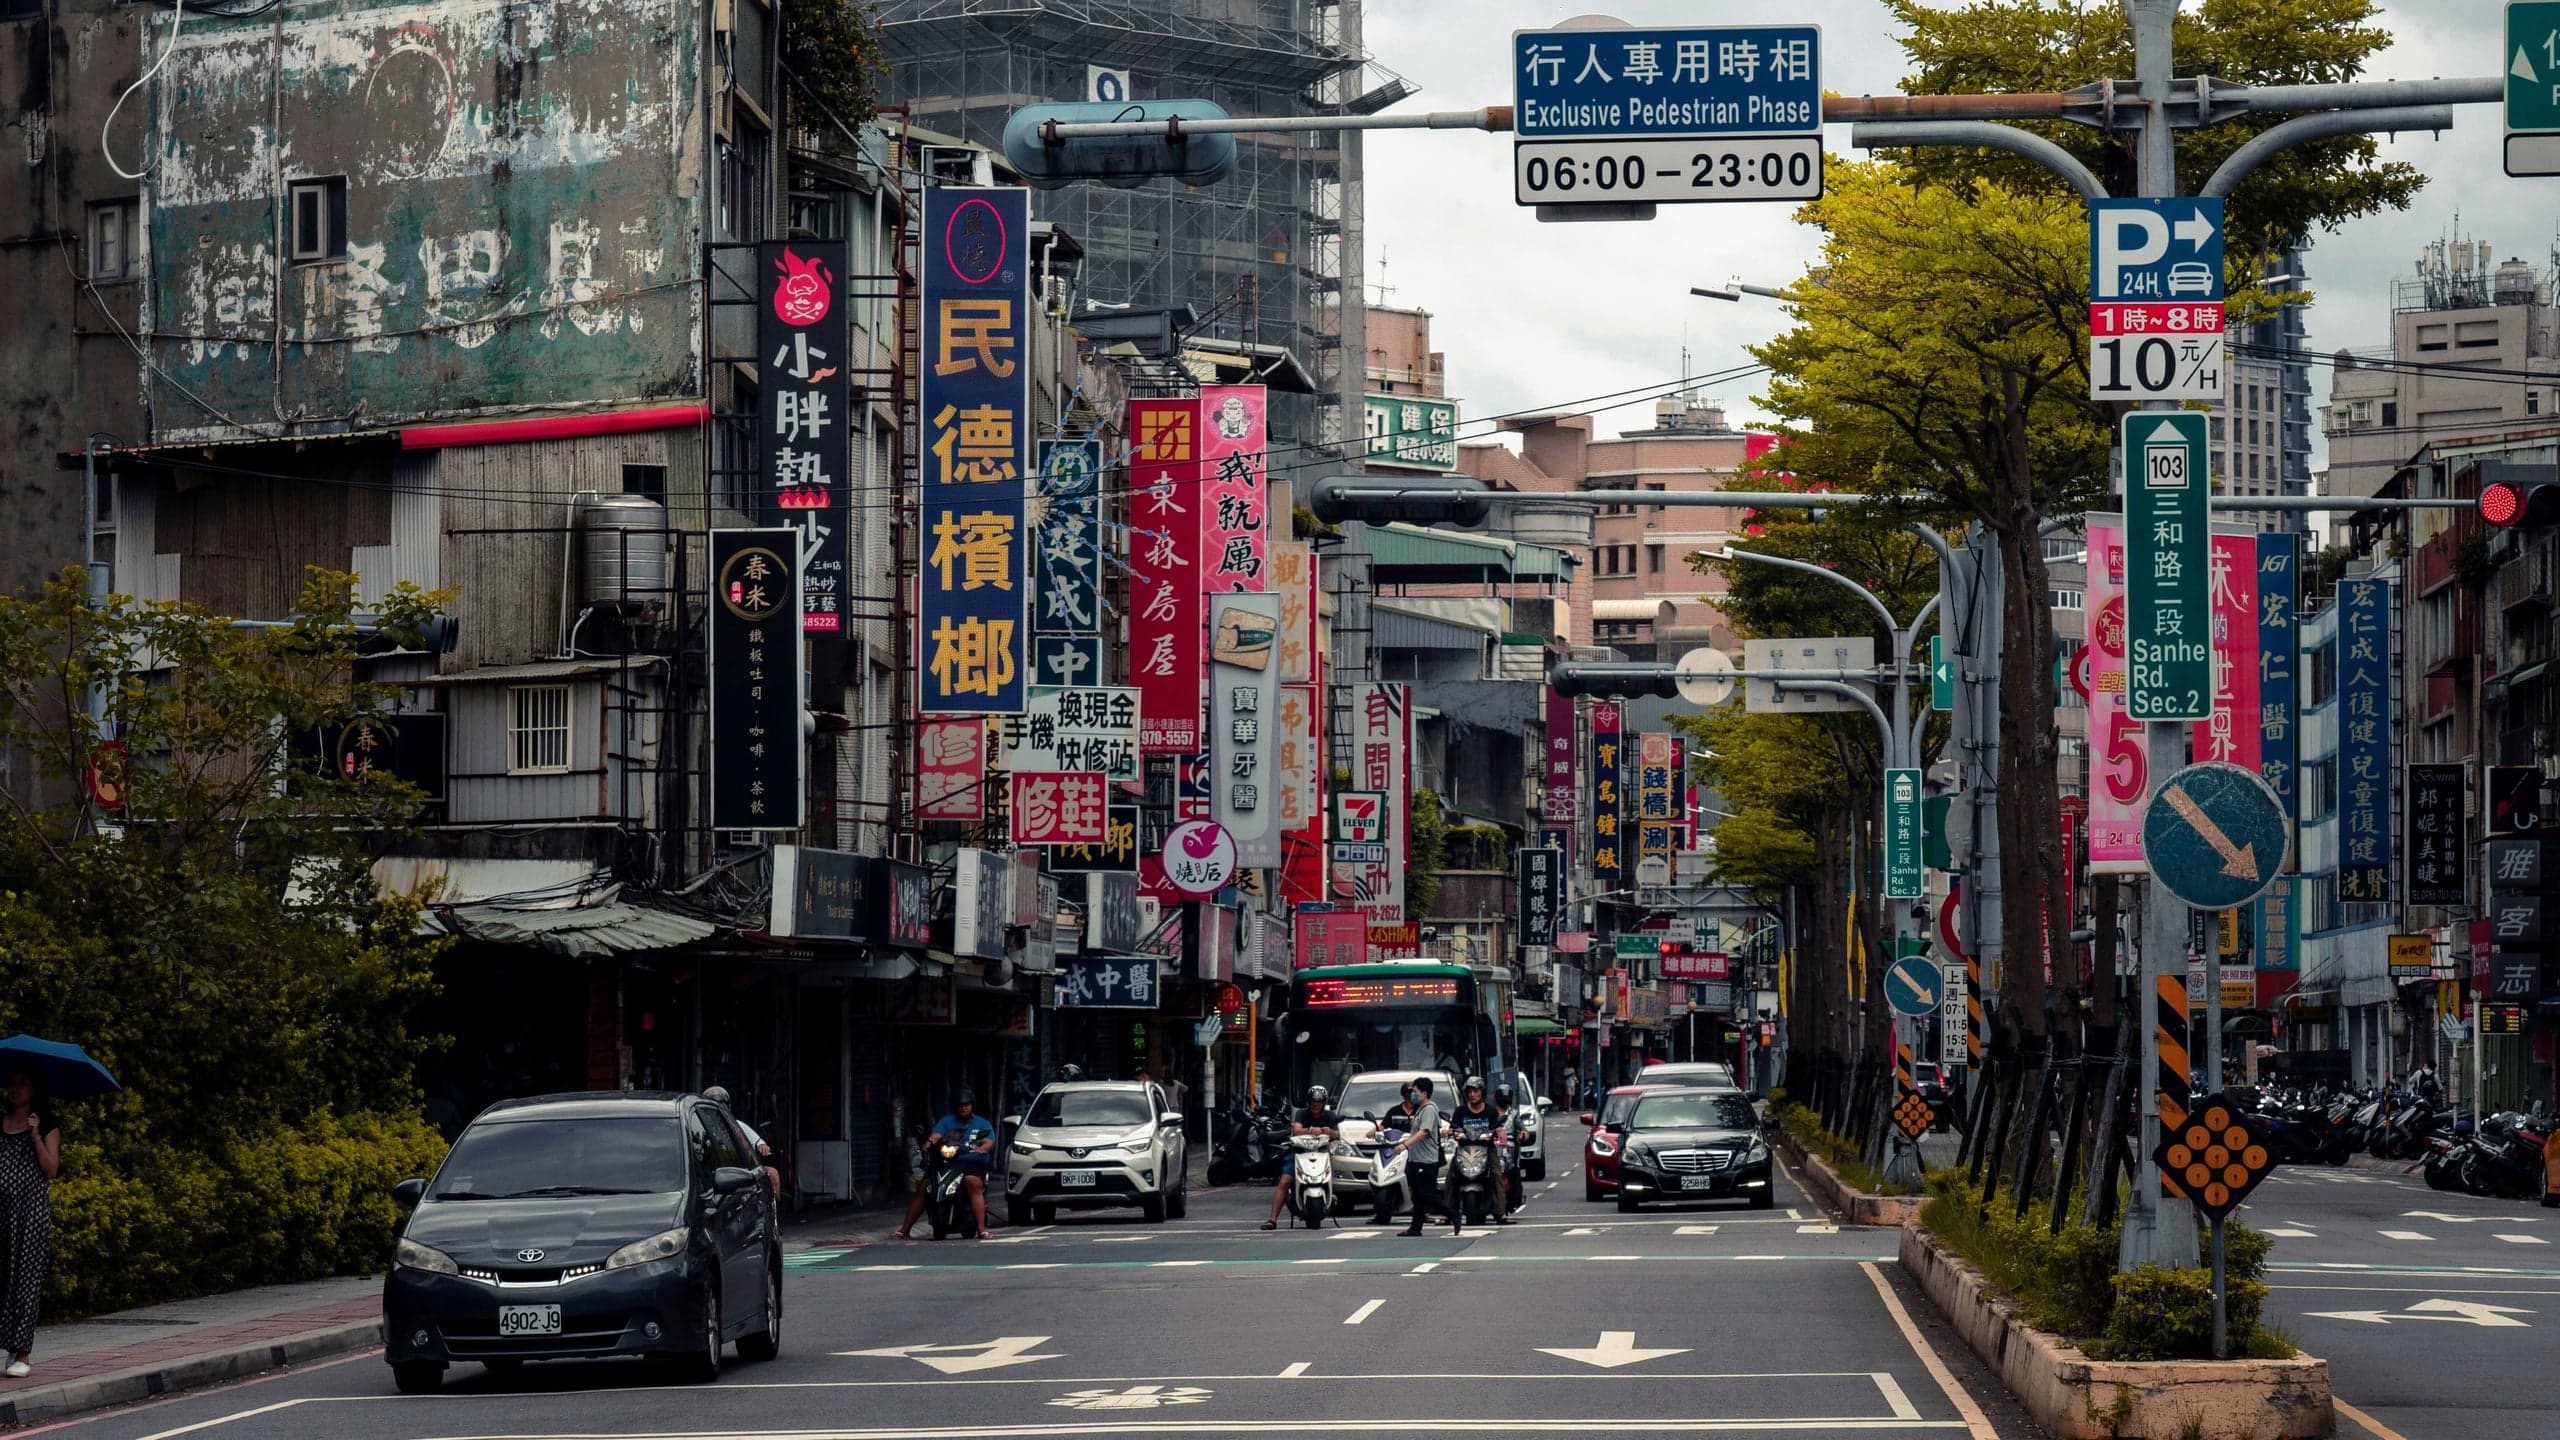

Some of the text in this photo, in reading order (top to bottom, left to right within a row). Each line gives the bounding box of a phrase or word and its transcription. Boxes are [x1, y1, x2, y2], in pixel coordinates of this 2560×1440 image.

[1525, 39, 1811, 87] 行人專用時相
[1524, 95, 1811, 127] Exclusive Pedestrian Phase
[2098, 208, 2170, 297] P
[2123, 272, 2159, 295] 24H
[2150, 455, 2183, 479] 103
[929, 299, 1017, 697] 民德檳榔
[744, 554, 771, 611] 春米
[814, 560, 842, 571] 三和店
[1141, 470, 1189, 677] 東森房屋
[2152, 493, 2184, 637] 三和路二段
[2133, 638, 2205, 663] Sanhe
[2134, 664, 2169, 689] Rd.
[2259, 592, 2291, 795] 宏仁醫院
[1004, 713, 1055, 750] 手機
[1058, 691, 1135, 729] 換現金
[1056, 737, 1134, 775] 快修站
[1232, 687, 1258, 811] 寶華牙醫
[1016, 777, 1101, 839] 修鞋
[1596, 744, 1620, 870] 寶島鐘錶
[1897, 789, 1910, 798] 103
[1898, 804, 1910, 864] 三和路二段
[2417, 786, 2439, 884] 邦妮美睫
[1891, 866, 1917, 875] Sanhe
[2342, 868, 2389, 898] 洗腎
[1530, 854, 1549, 934] 國輝眼鏡
[1367, 927, 1416, 943] KASHIMA
